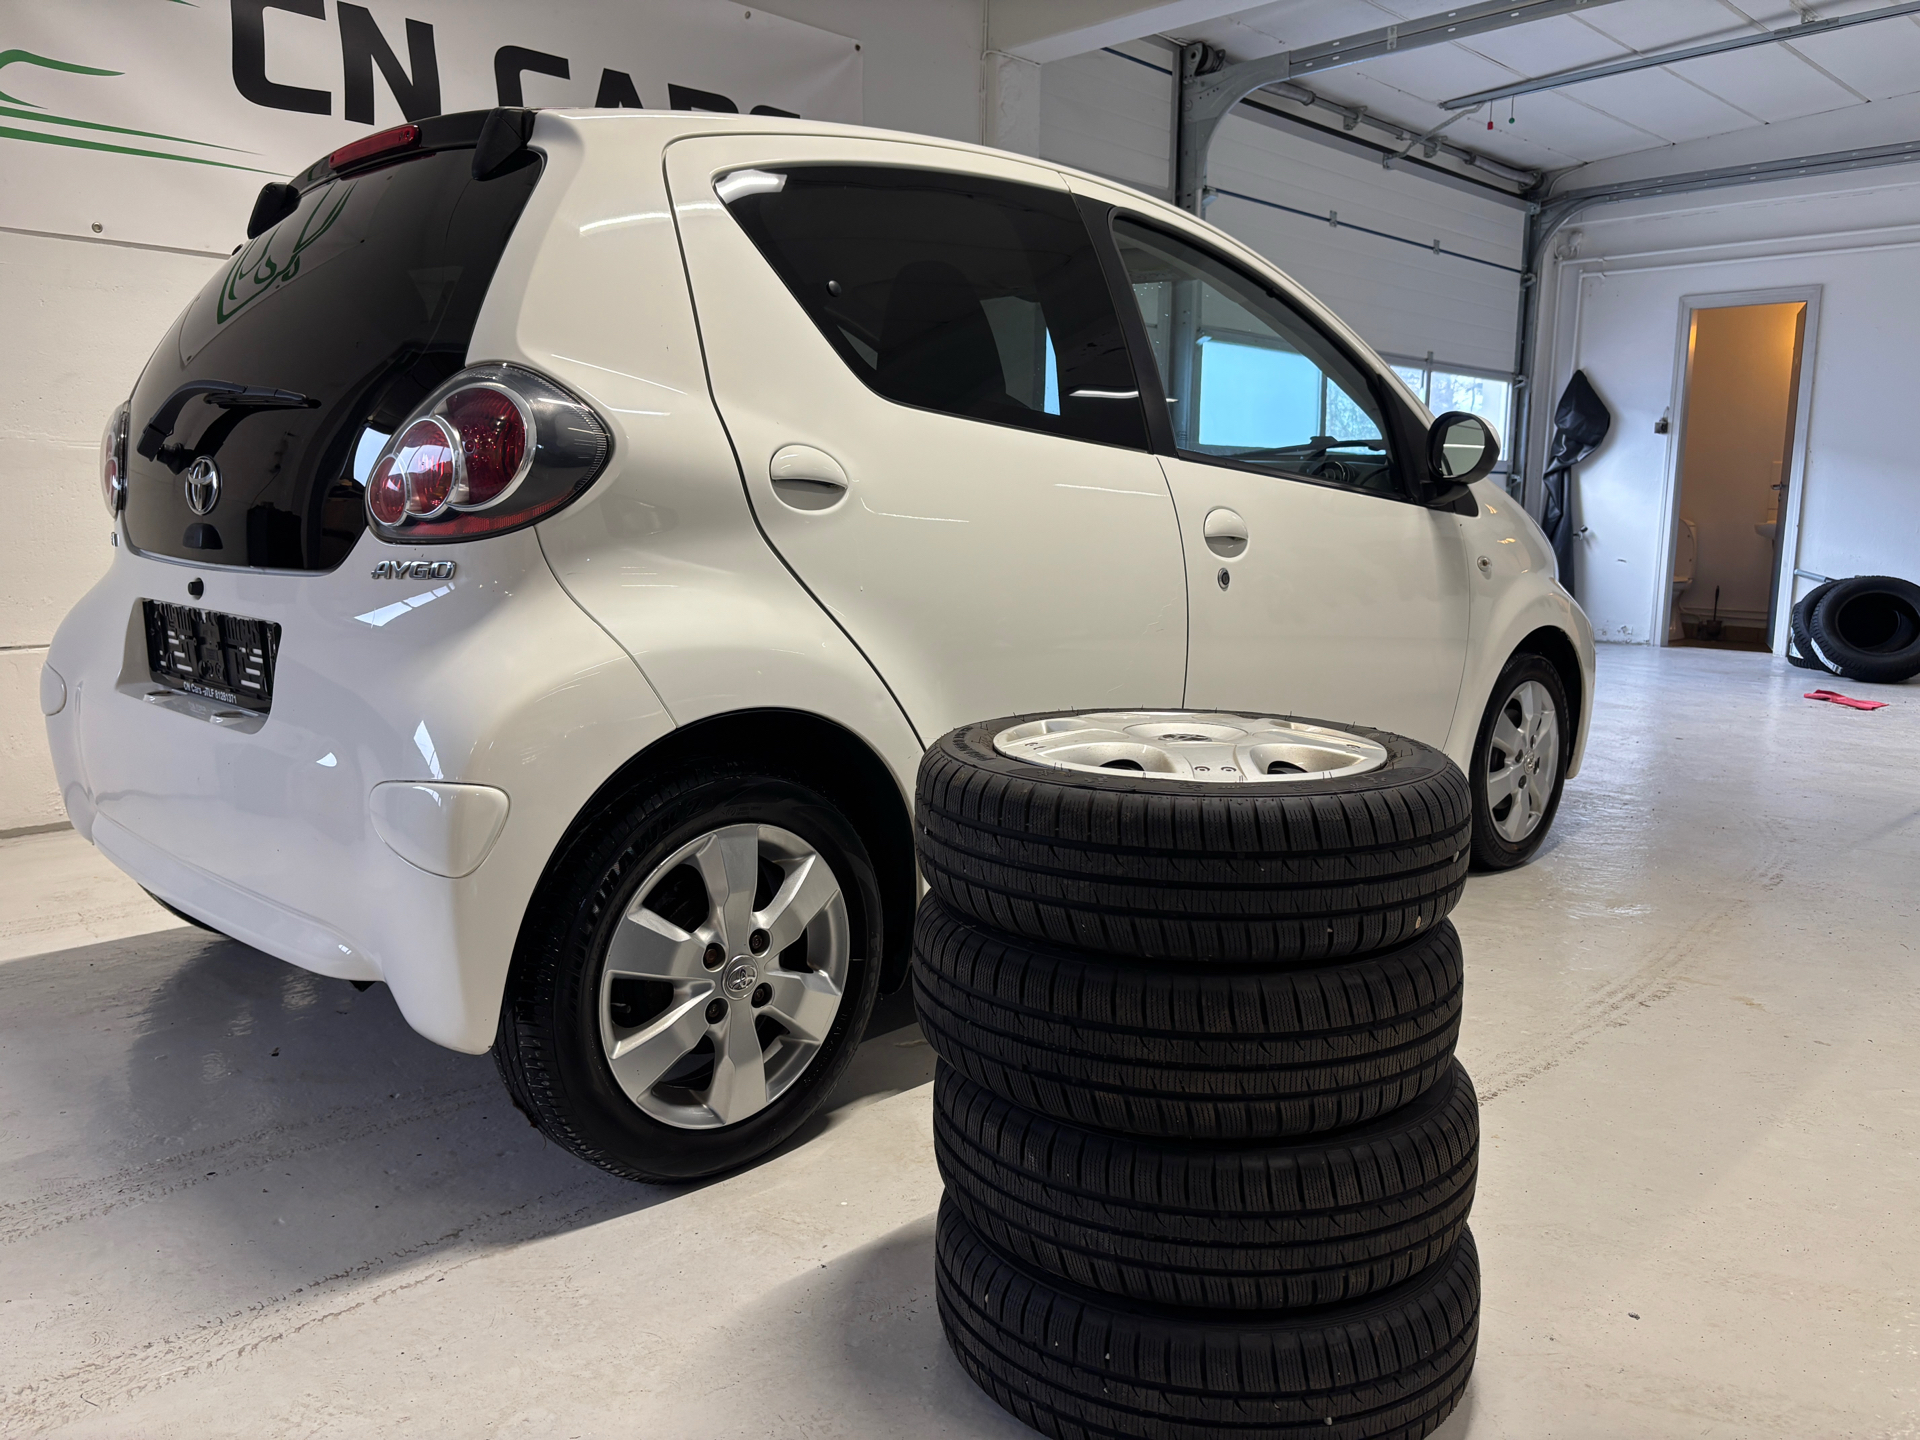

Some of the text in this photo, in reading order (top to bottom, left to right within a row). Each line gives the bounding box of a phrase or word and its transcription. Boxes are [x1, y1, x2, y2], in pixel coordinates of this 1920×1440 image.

[230, 0, 442, 126] CN
[371, 560, 457, 580] AYGO
[183, 681, 191, 692] CN
